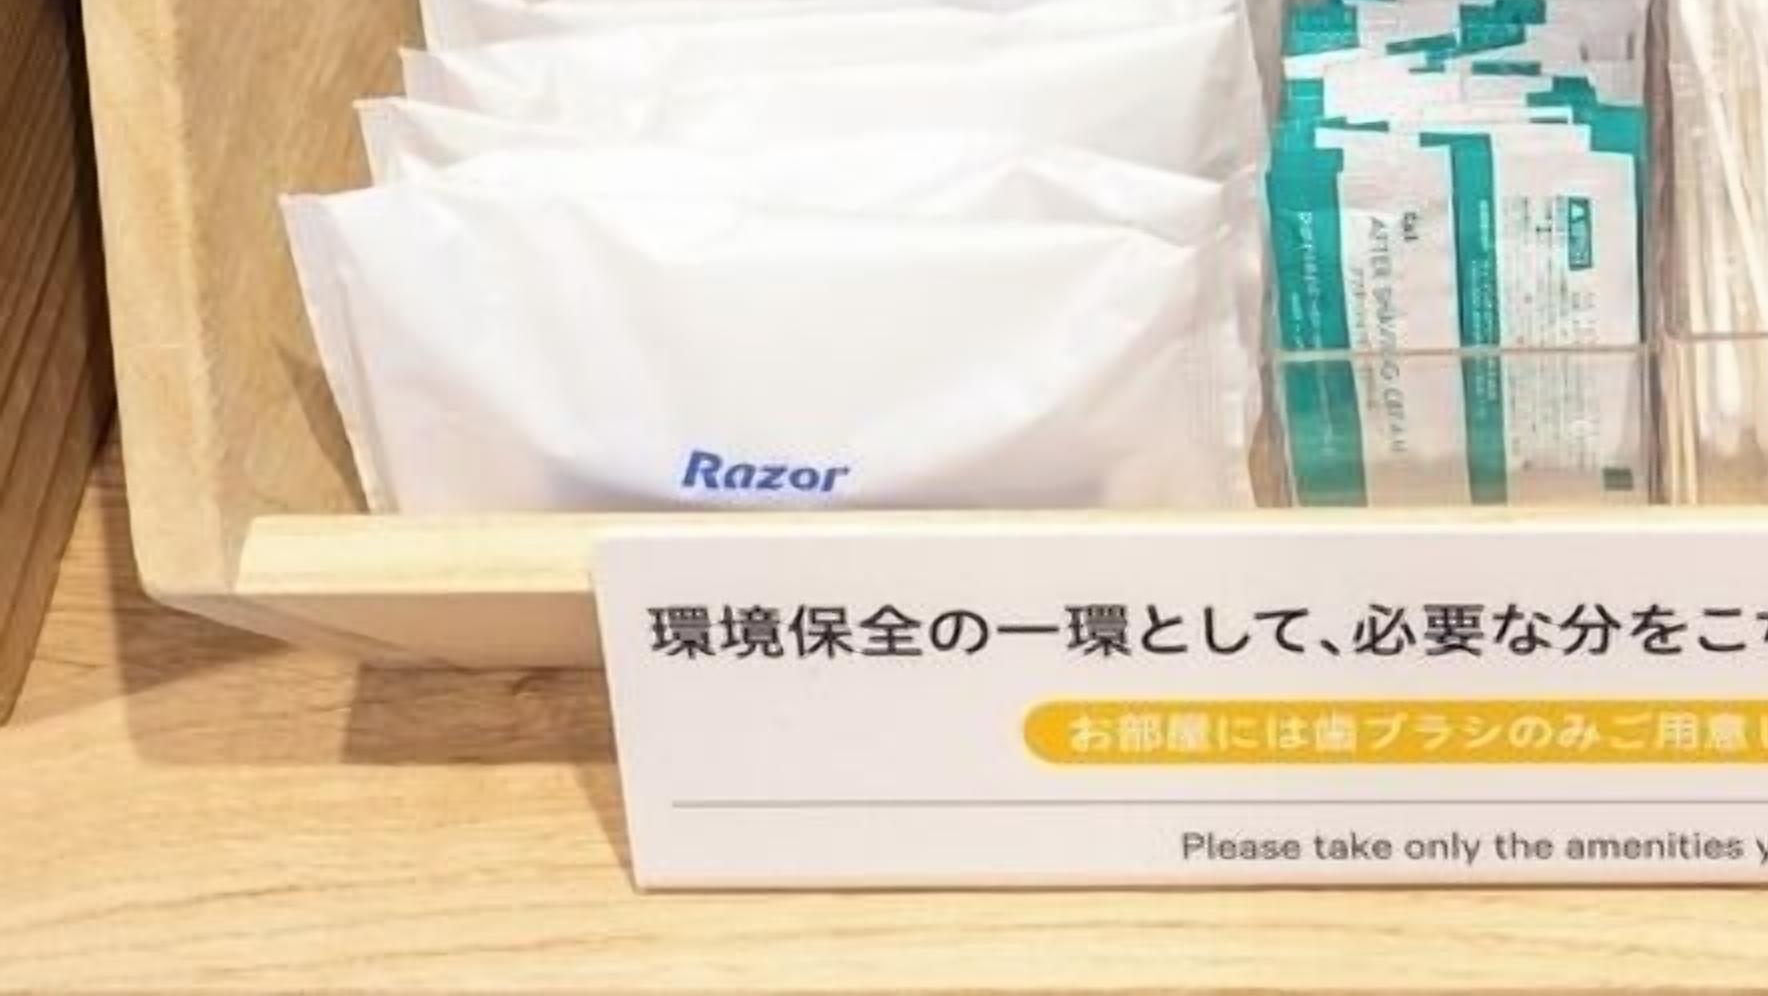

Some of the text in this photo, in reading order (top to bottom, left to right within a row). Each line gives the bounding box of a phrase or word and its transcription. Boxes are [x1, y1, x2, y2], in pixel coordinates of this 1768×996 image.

[681, 449, 851, 492] Razor
[1181, 830, 1301, 861] Please
[1313, 831, 1394, 861] take
[1403, 831, 1481, 866] only
[1494, 831, 1554, 861] the
[1565, 831, 1744, 861] amenities
